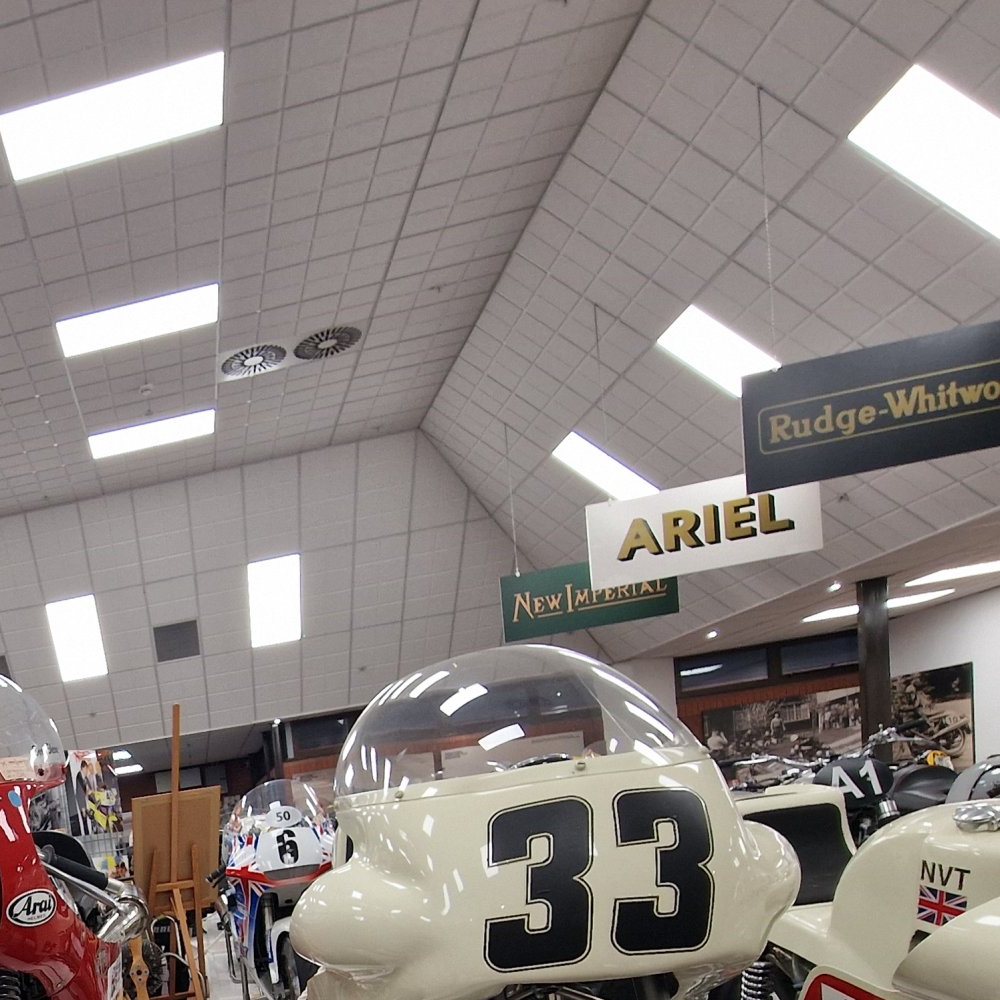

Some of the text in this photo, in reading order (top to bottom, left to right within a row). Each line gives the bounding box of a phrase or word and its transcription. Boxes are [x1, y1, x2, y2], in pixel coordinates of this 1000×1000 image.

[616, 492, 795, 562] ARIEL
[828, 758, 884, 799] A1
[275, 810, 291, 822] 50
[276, 829, 299, 865] 6
[484, 786, 714, 973] 33
[920, 859, 971, 891] NVT
[13, 894, 51, 917] Arai
